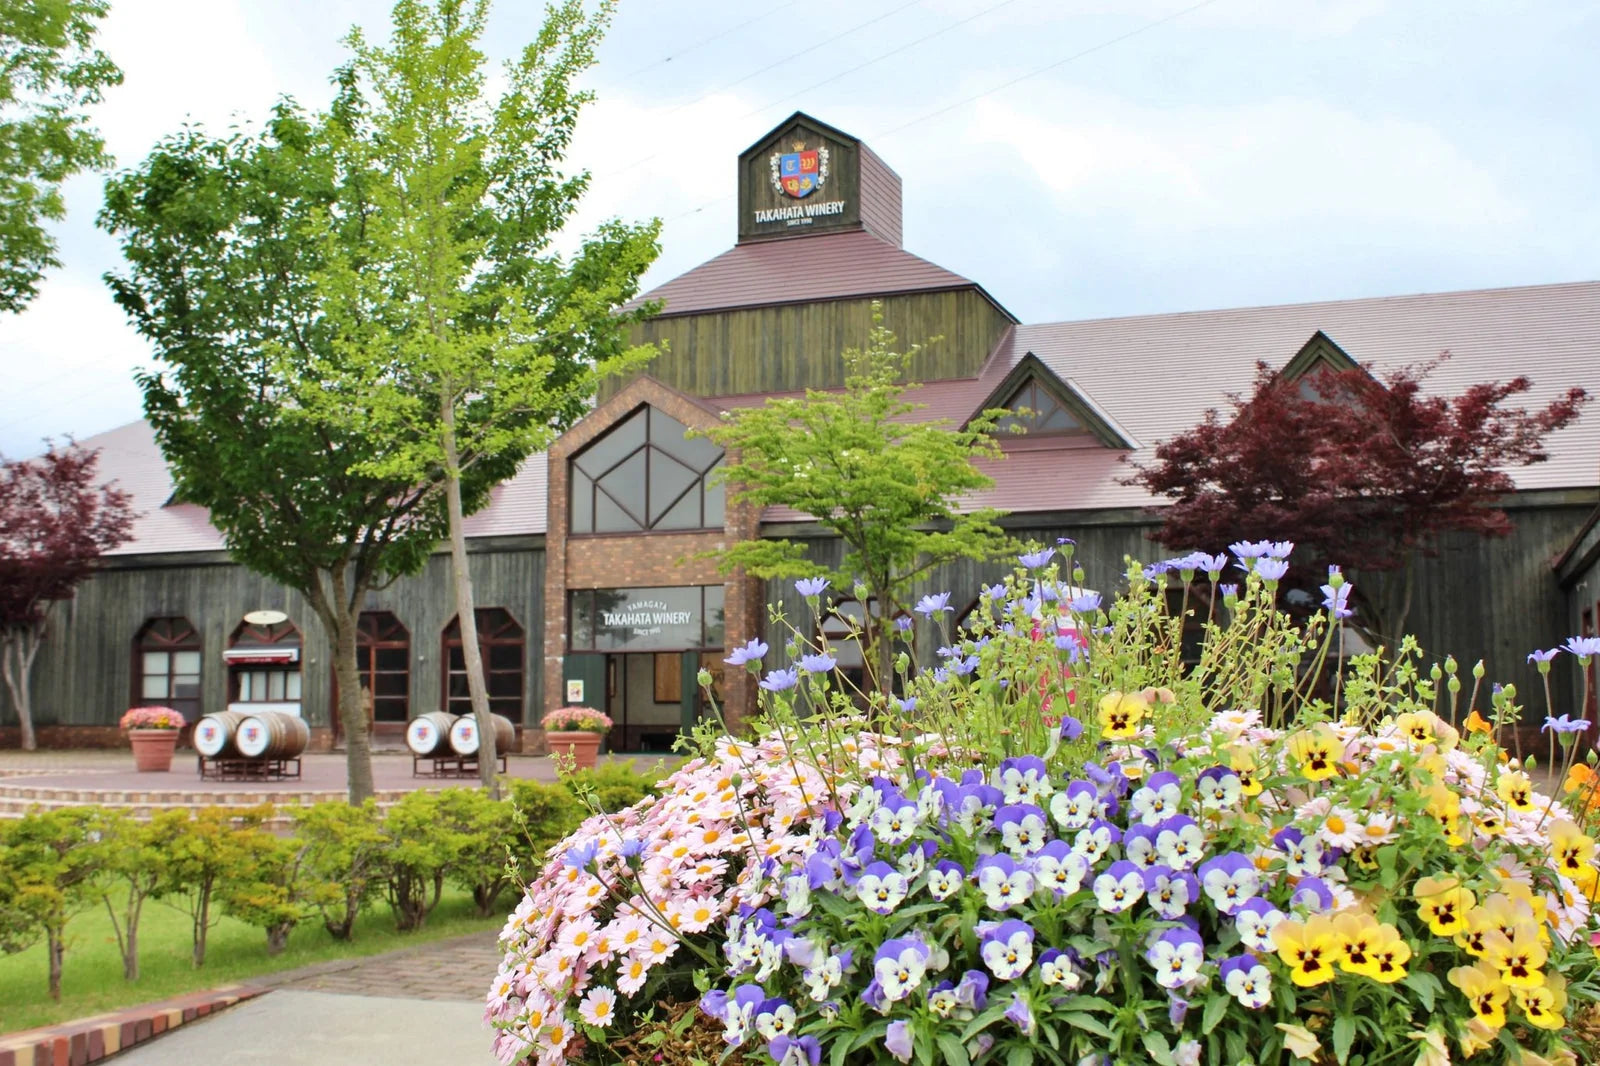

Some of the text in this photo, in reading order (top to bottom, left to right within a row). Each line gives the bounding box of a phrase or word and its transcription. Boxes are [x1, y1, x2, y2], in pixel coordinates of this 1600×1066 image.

[755, 201, 845, 223] TAKAHATA WINERY
[627, 600, 668, 612] YAMAGATA
[603, 611, 691, 626] TAKAHATA WINERY
